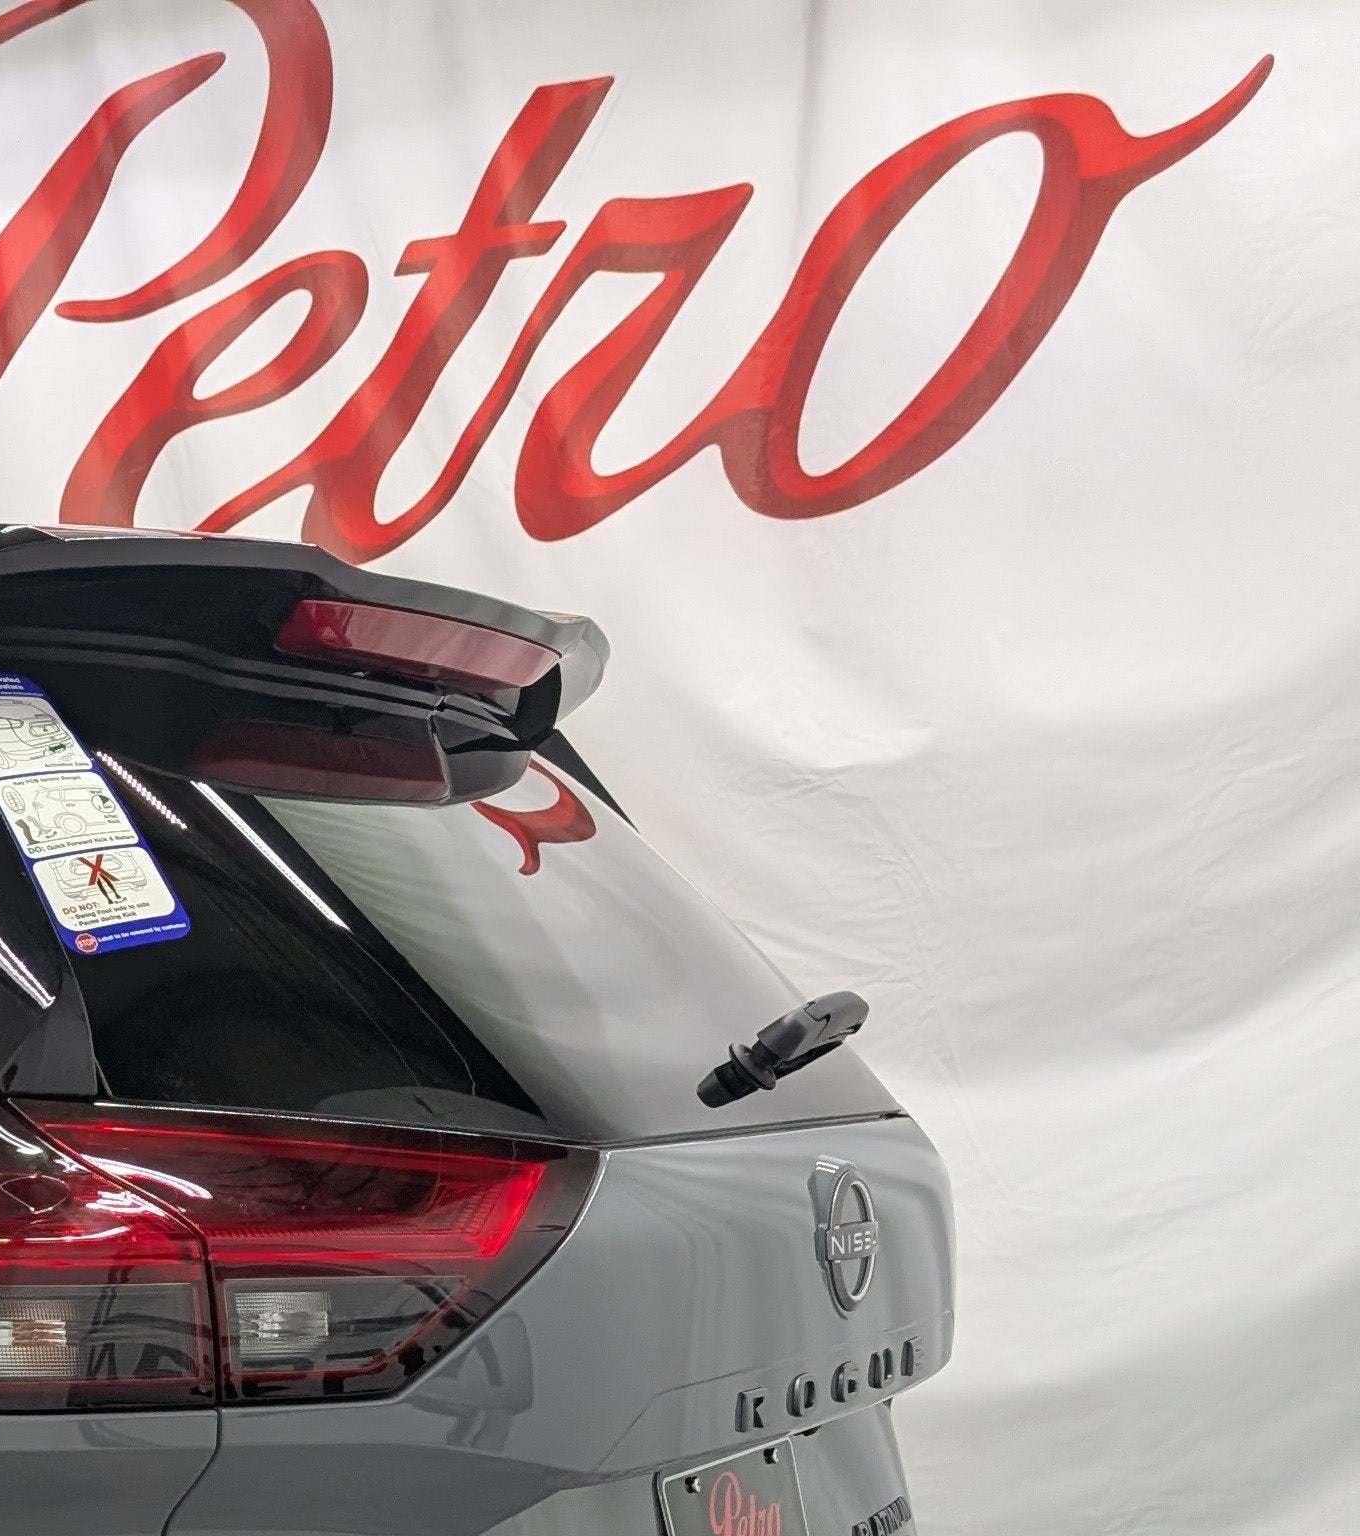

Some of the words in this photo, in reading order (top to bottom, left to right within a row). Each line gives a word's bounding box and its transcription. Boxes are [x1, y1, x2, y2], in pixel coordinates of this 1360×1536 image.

[27, 845, 45, 854] DO:
[67, 839, 93, 847] Forward
[62, 906, 77, 915] DO
[78, 901, 100, 911] NOT:
[77, 937, 97, 948] STOP
[831, 1230, 877, 1256] NISS
[734, 1336, 923, 1433] ROGUE
